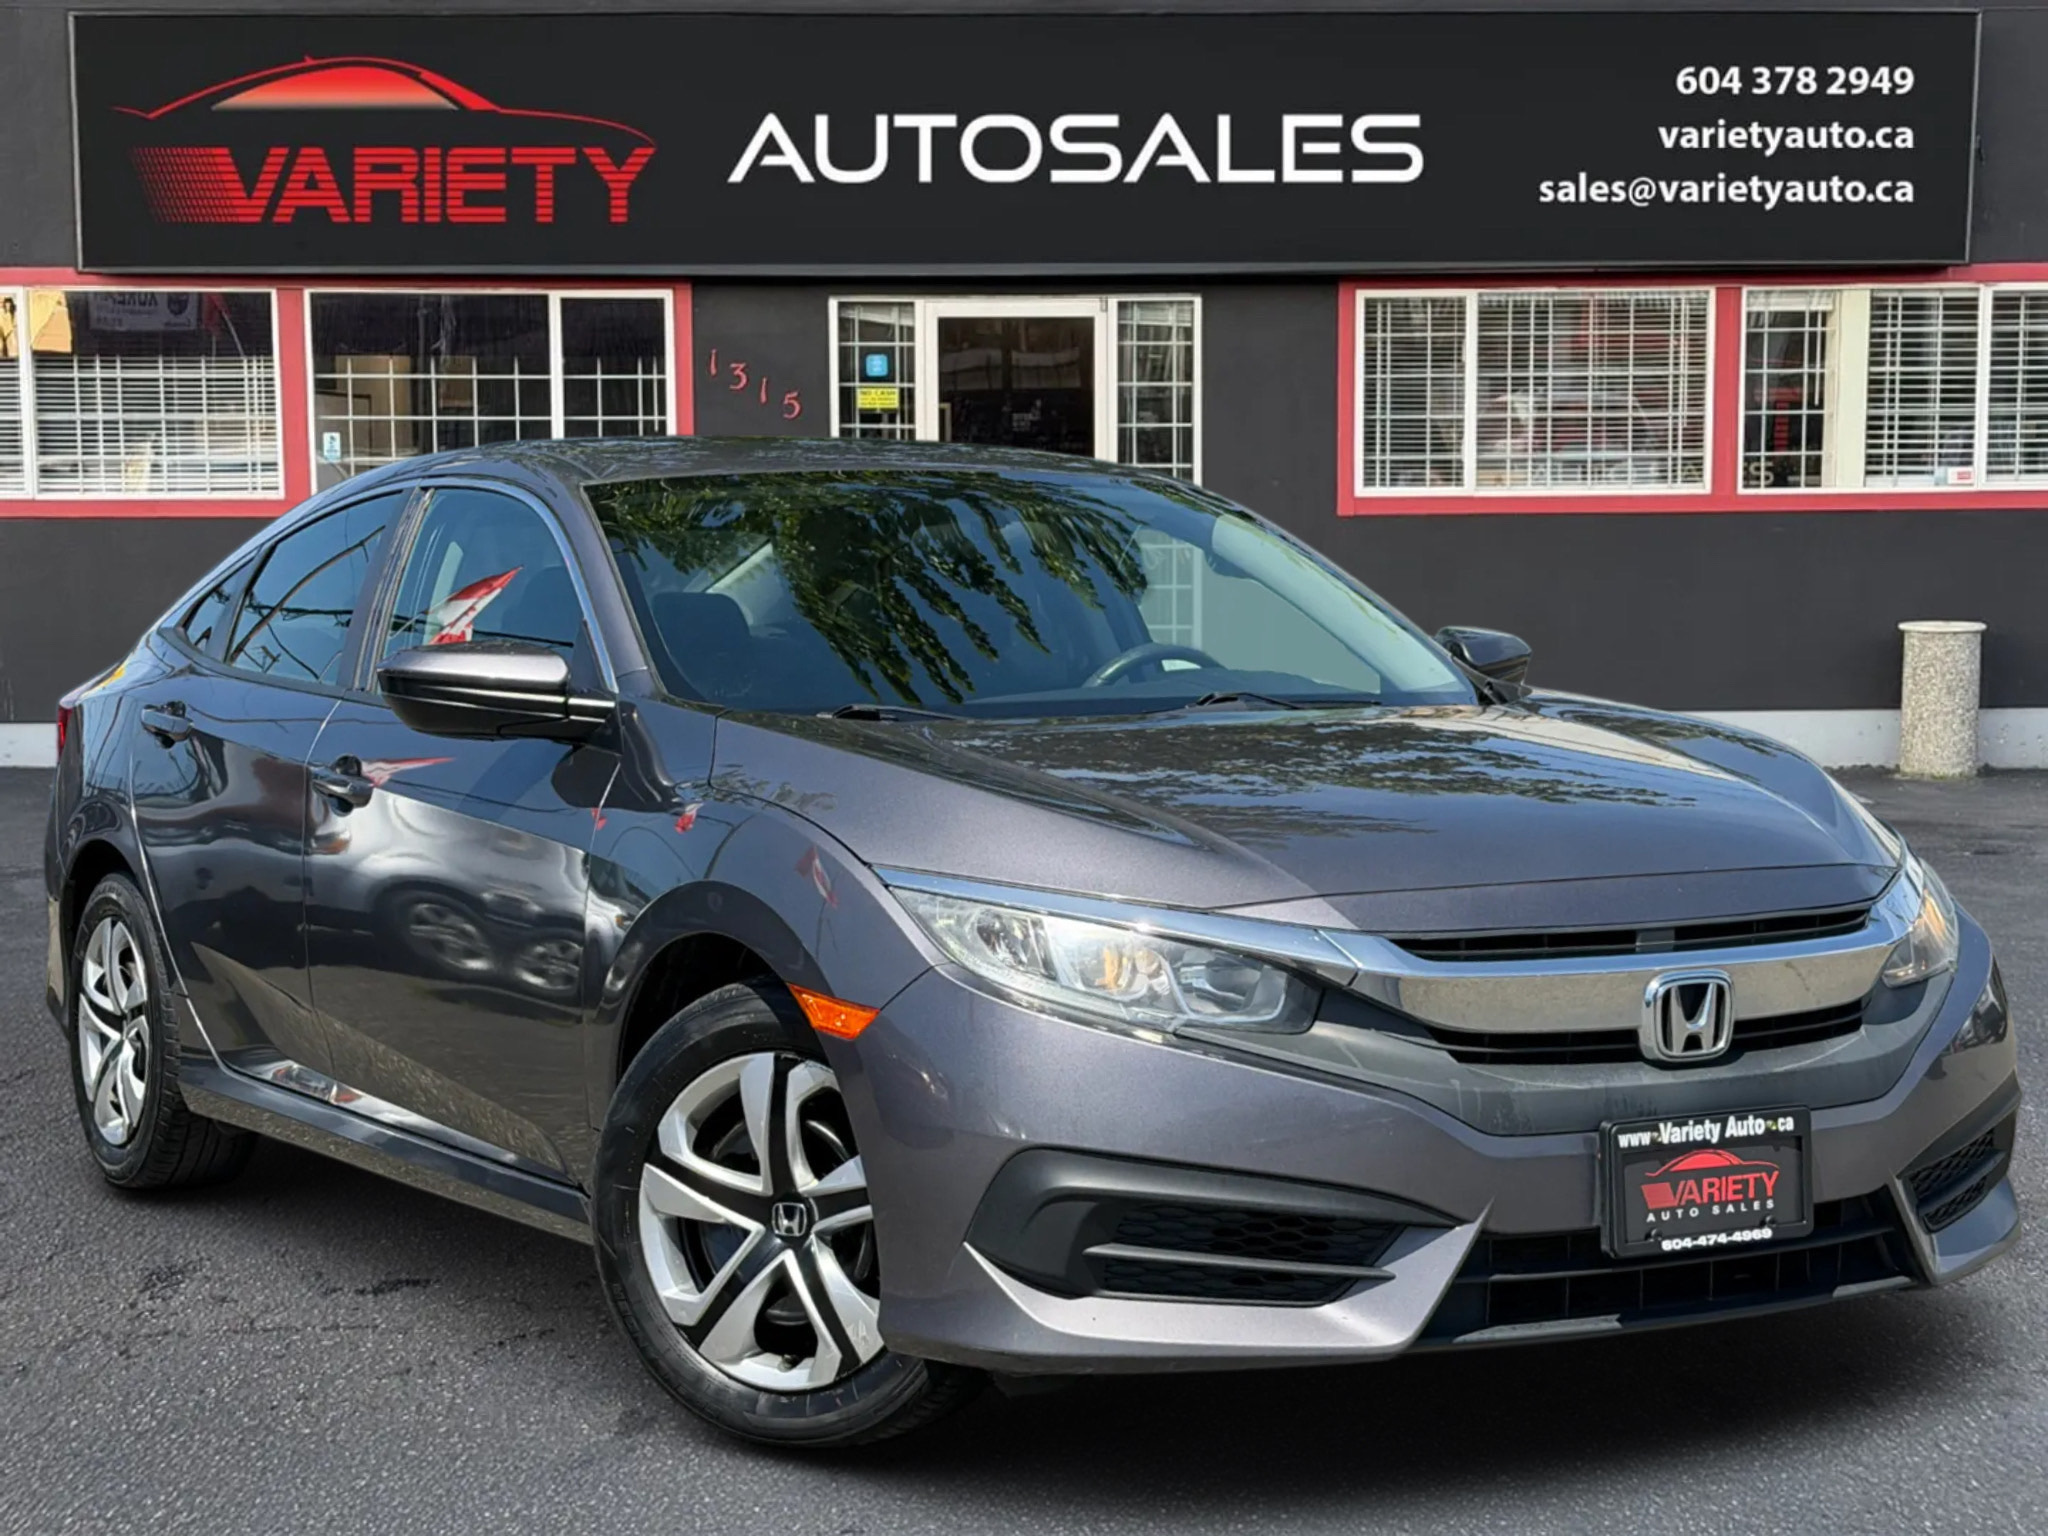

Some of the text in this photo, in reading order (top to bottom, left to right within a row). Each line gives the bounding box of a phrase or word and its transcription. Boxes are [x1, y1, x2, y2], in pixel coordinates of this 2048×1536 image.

[1676, 66, 1915, 95] 604 378 2949
[727, 112, 1424, 184] AUTOSALES
[1658, 119, 1914, 157] varietyauto.ca
[130, 146, 656, 223] VARIETY
[1539, 171, 1914, 211] sales@varietyauto.ca
[709, 348, 801, 419] 1315
[1640, 1170, 1780, 1210] VARIETY
[1646, 1199, 1775, 1223] AUTO SALES
[1661, 1227, 1773, 1252] 604-474-4969
